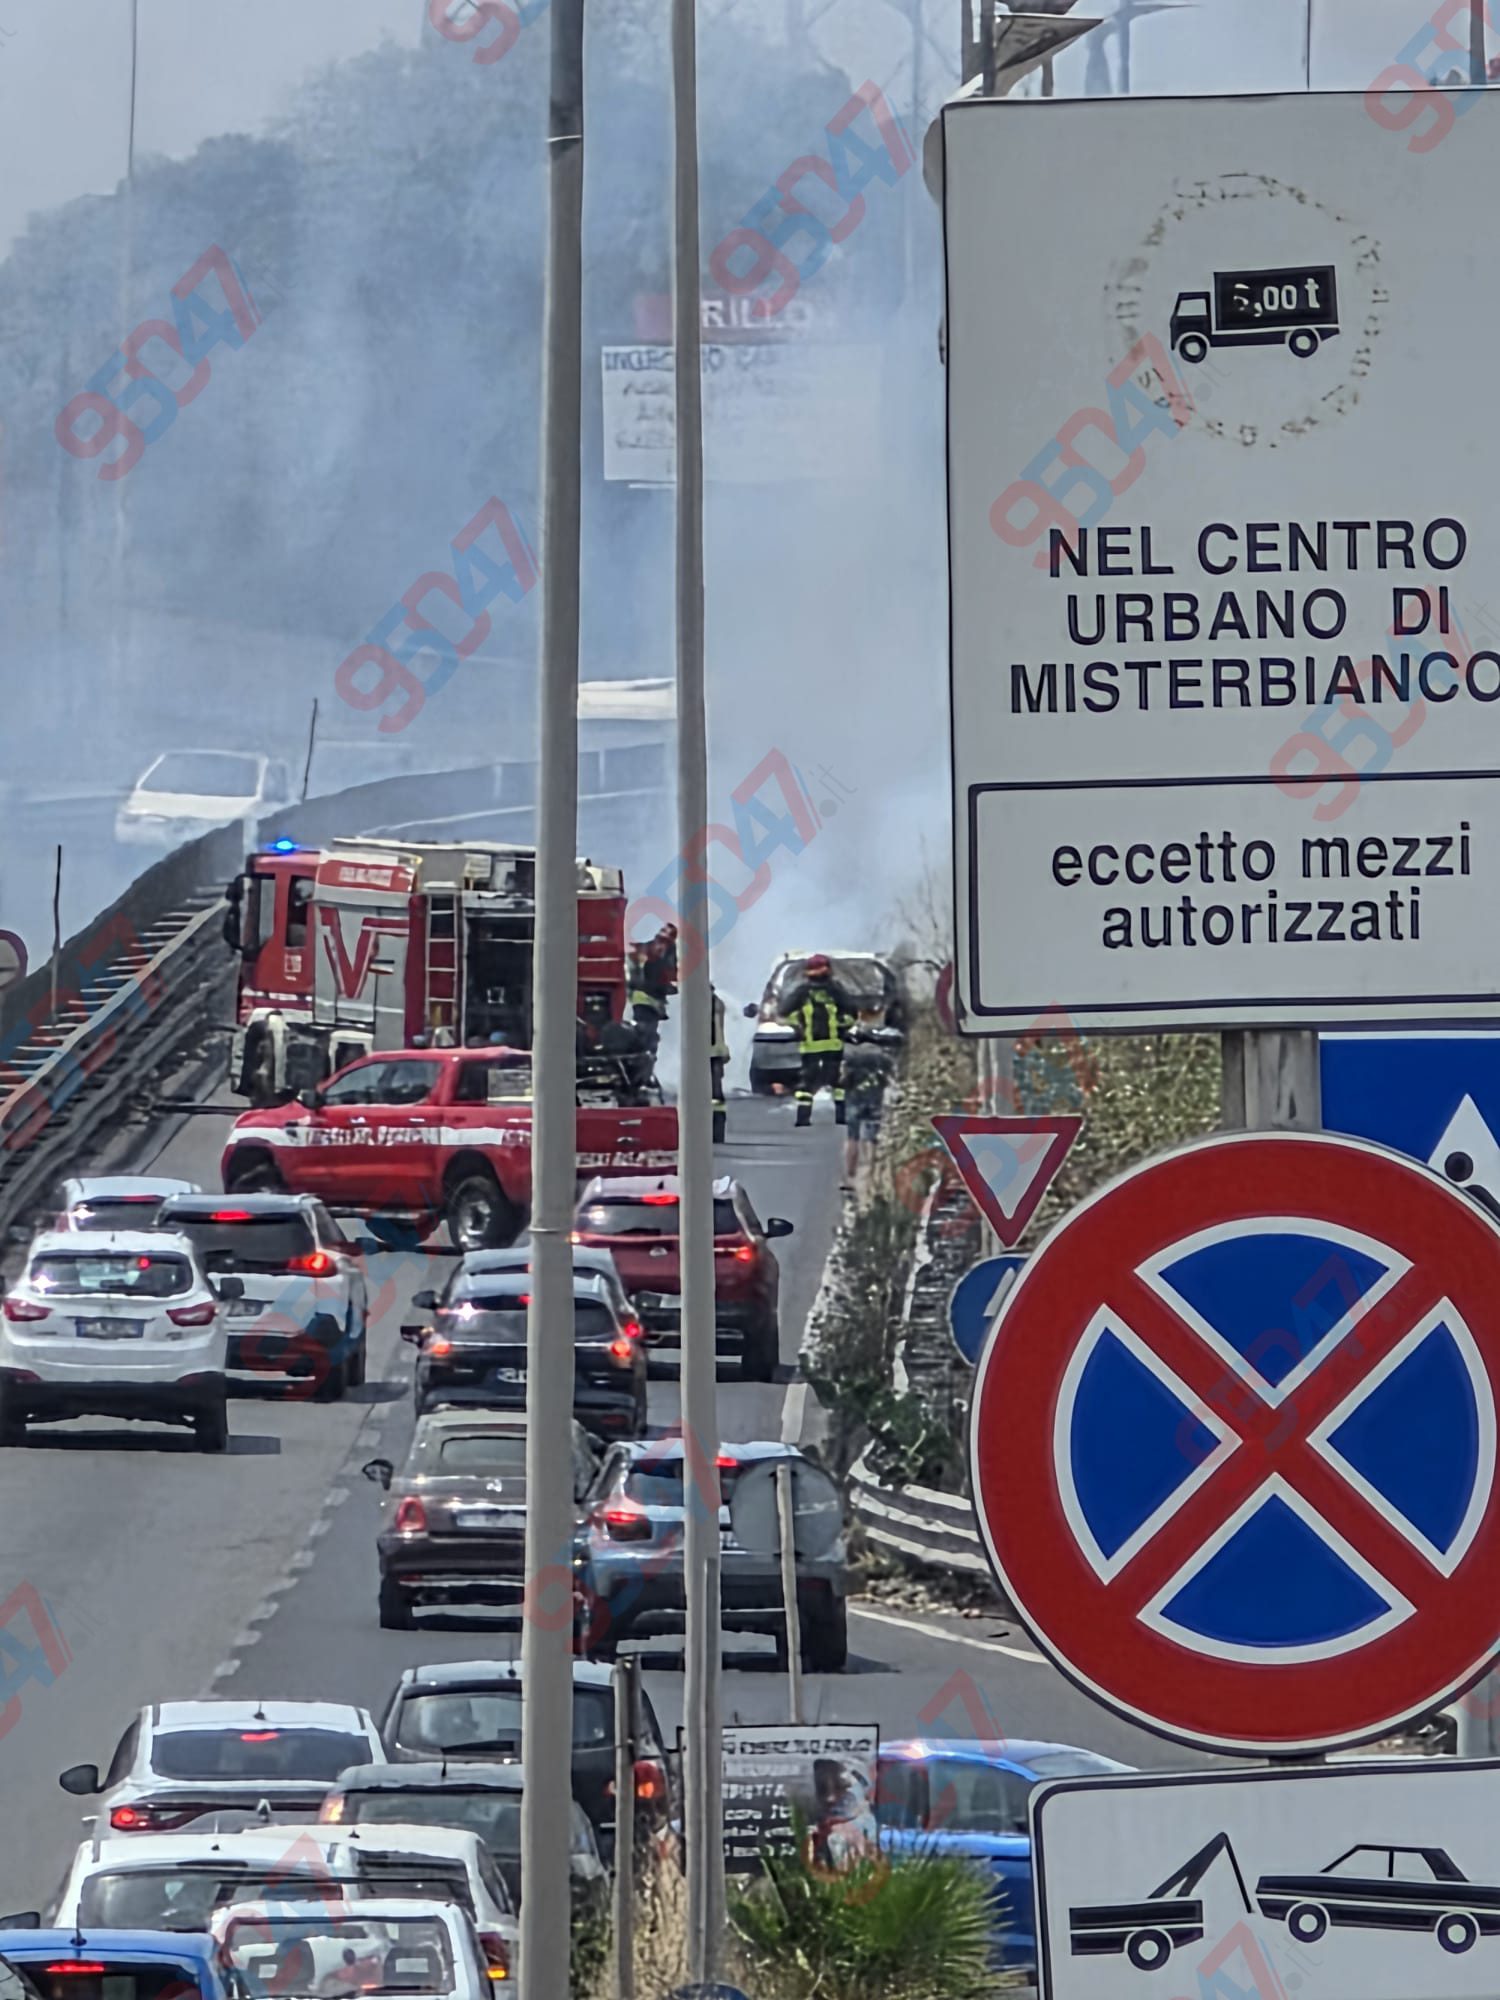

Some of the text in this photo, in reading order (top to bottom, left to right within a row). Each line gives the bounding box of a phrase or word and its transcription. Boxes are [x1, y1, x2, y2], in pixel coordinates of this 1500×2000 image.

[1304, 277, 1321, 309] t
[1049, 518, 1467, 578] NEL CENTRO
[1067, 585, 1451, 646] URBANO DI
[1010, 651, 1500, 714] MISTERBIANCO
[1052, 821, 1472, 887] eccetto mezzi
[1102, 886, 1421, 950] autorizzati
